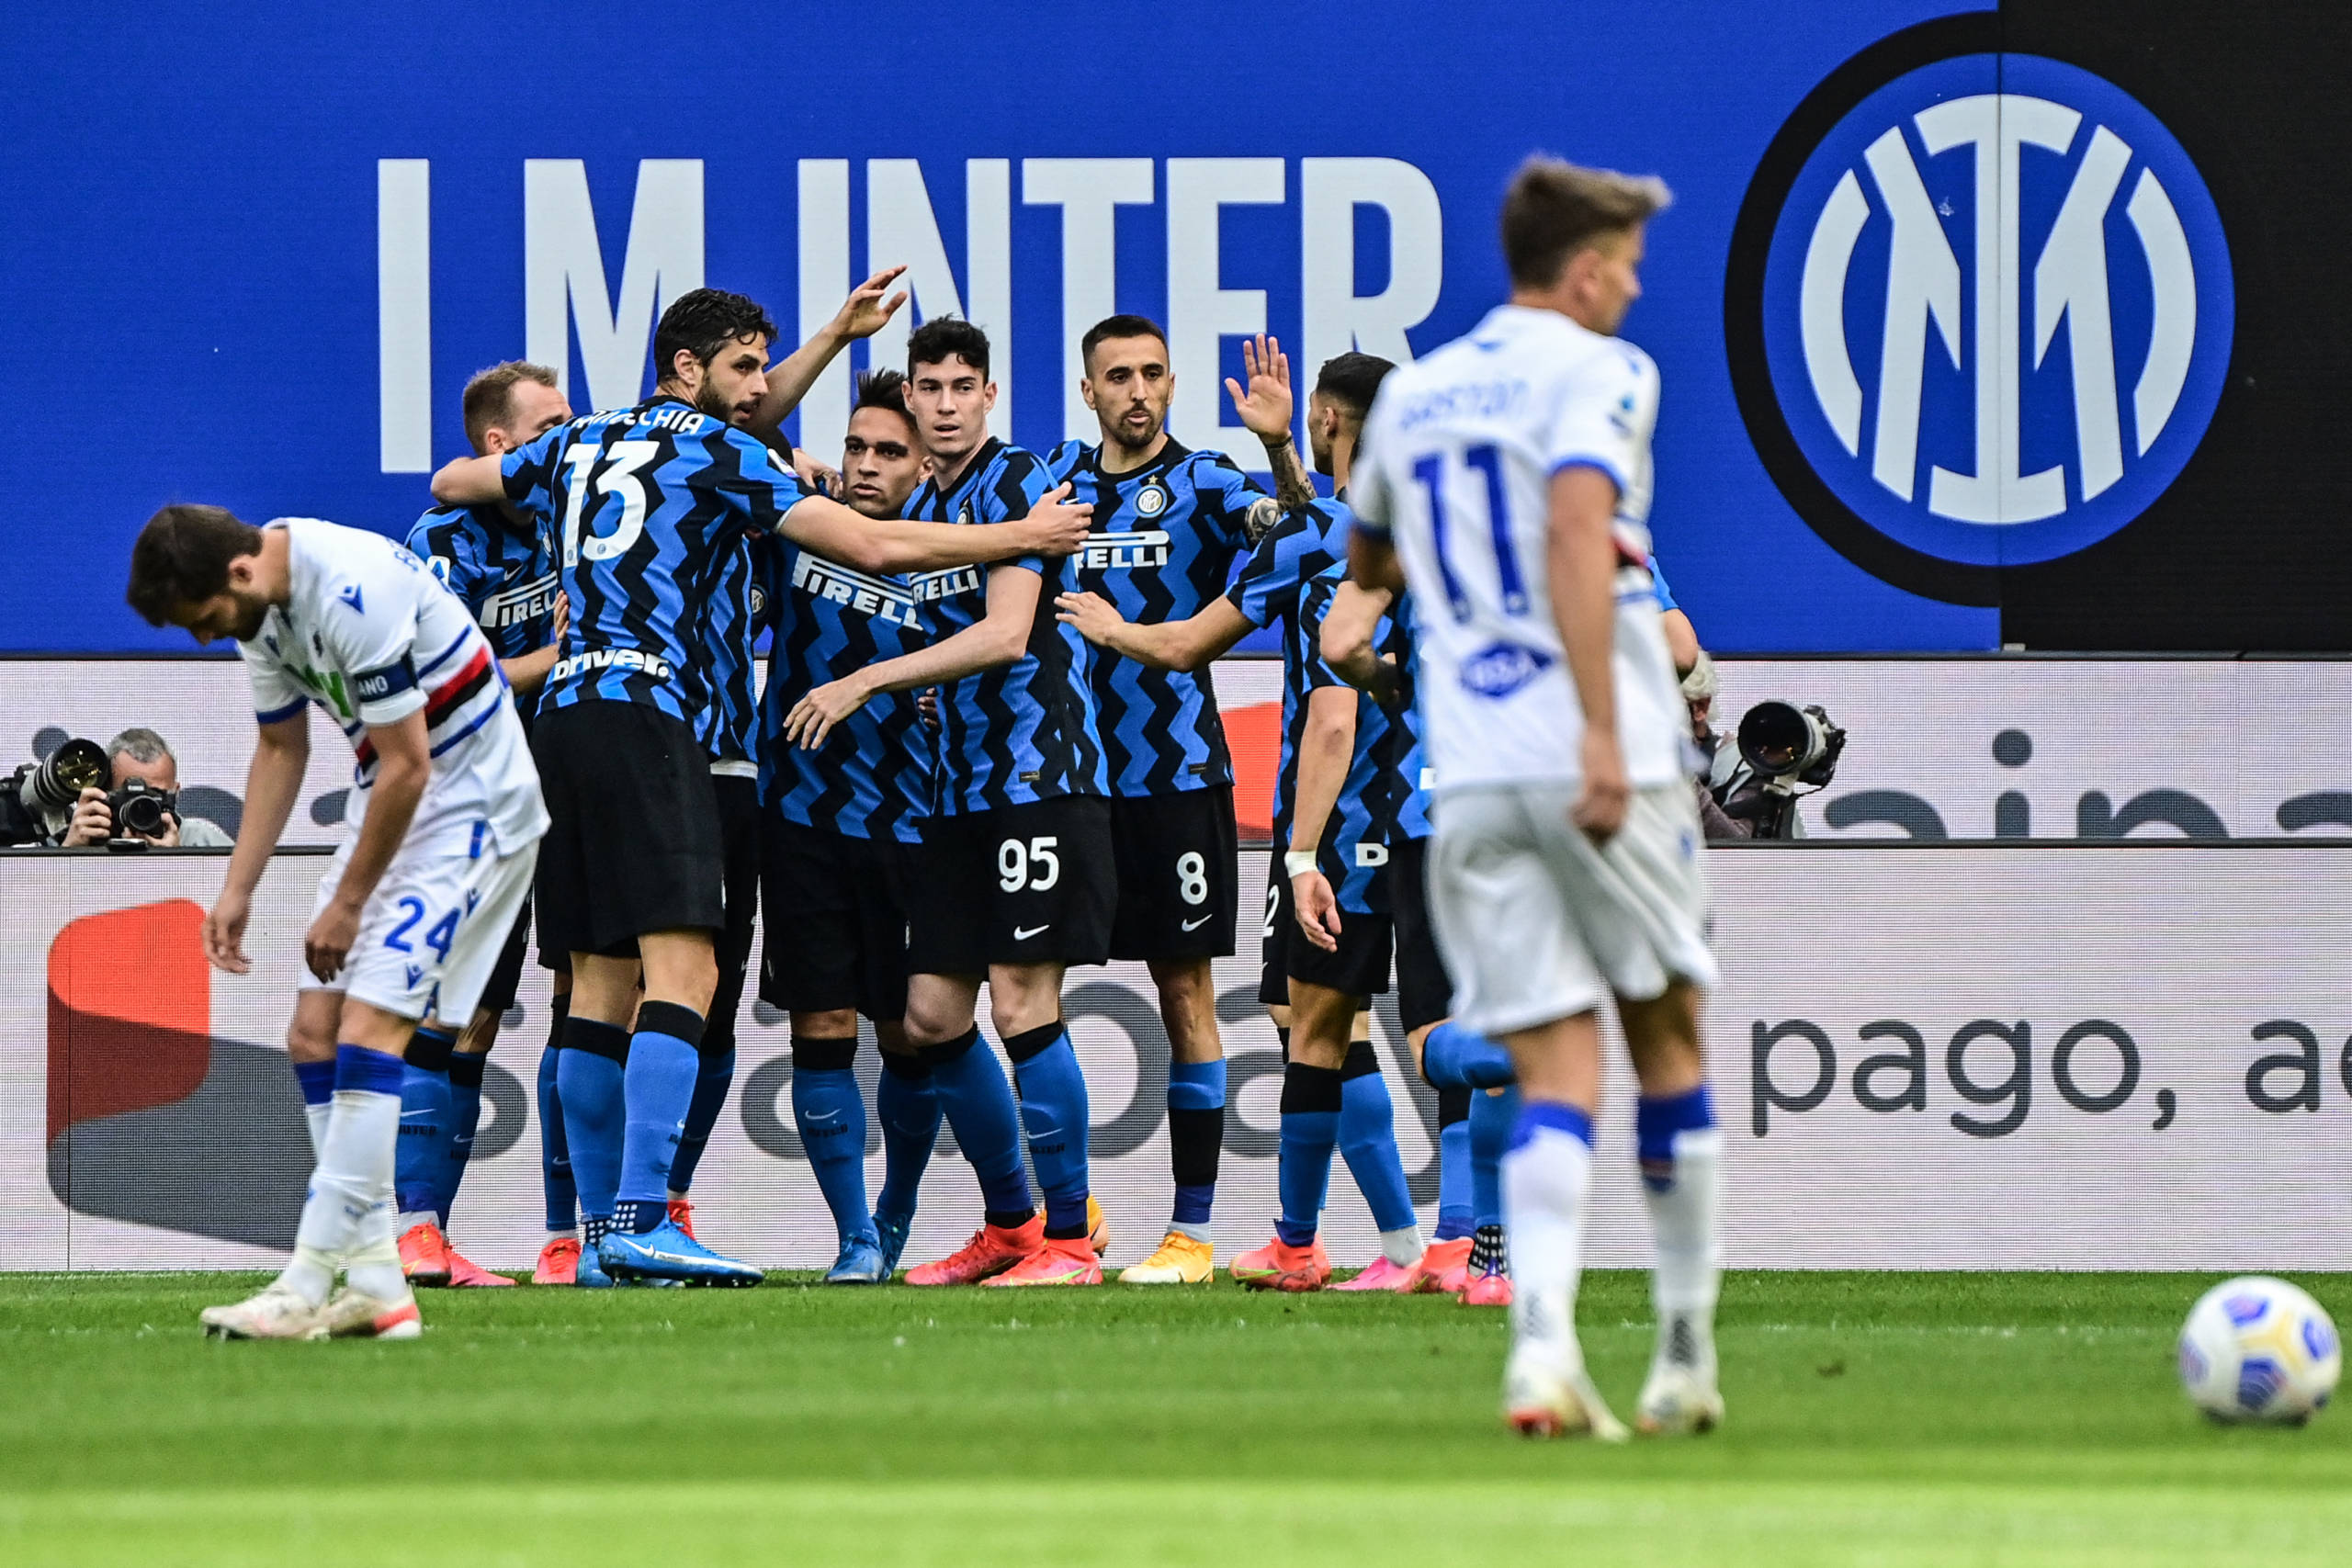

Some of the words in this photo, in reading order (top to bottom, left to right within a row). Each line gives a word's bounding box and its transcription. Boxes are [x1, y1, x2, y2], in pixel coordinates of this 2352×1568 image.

[378, 158, 432, 473] I
[524, 158, 706, 413] M
[797, 157, 1443, 473] INTER
[563, 440, 661, 569] 13
[1412, 443, 1531, 625] 11
[909, 563, 980, 605] RELLI
[1072, 530, 1170, 570] RELLI
[479, 570, 558, 628] PIREL
[791, 550, 924, 631] PIRELL
[998, 836, 1060, 893] 95
[1176, 852, 1208, 905] 8
[384, 895, 463, 964] 24
[1751, 1019, 2177, 1138] pago,
[2245, 1019, 2352, 1113] a
